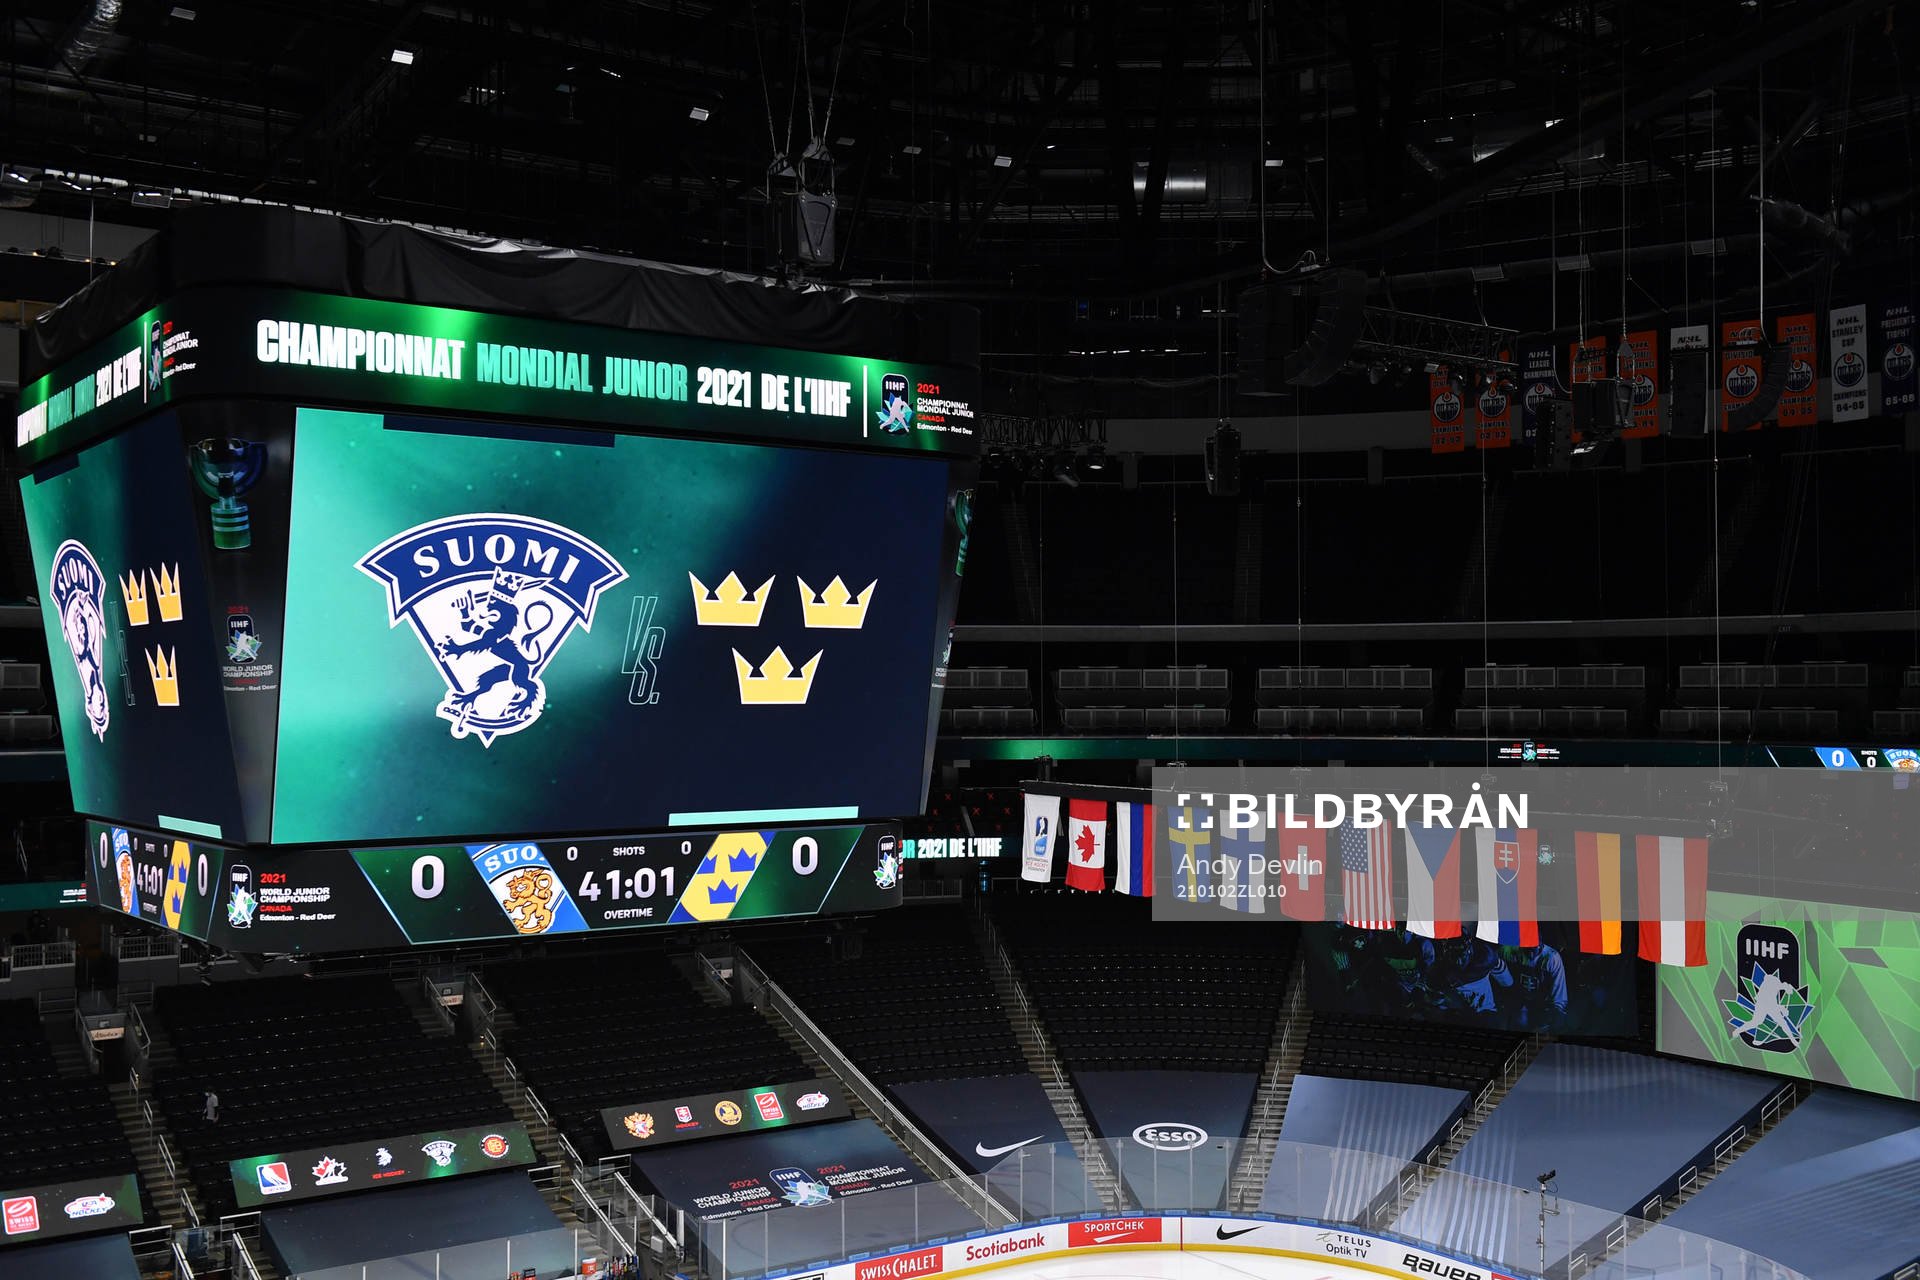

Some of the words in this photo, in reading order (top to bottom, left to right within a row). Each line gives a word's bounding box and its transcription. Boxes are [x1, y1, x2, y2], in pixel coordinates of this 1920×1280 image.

[1837, 316, 1860, 326] NHL
[1832, 325, 1864, 338] STANLEY
[1528, 351, 1551, 359] NHL
[256, 319, 466, 380] CHAMPIONNAT
[477, 343, 593, 393] MONDIAL
[602, 357, 688, 402] JUNIOR
[697, 366, 751, 409] 2021
[761, 373, 789, 412] DE
[795, 377, 851, 418] L'IIHF
[1529, 360, 1551, 369] LEAGUE
[885, 380, 905, 391] IIHF
[917, 383, 940, 395] 2021
[916, 397, 968, 410] CHAMPIONNAT
[916, 405, 951, 416] MONDIAL
[952, 409, 974, 419] JUNIOR
[916, 413, 945, 423] CANADA
[916, 423, 947, 432] Edmonton
[412, 534, 582, 586] SUOMI
[58, 557, 95, 600] SUOMI
[223, 670, 274, 678] CHAMPIONSHIP
[245, 664, 273, 672] JUNIOR
[1831, 750, 1845, 767] 0
[1866, 756, 1877, 768] 0
[115, 832, 130, 853] SUO
[133, 837, 138, 851] 0
[681, 840, 692, 855] 0
[918, 838, 947, 858] 2021
[949, 838, 966, 857] DE
[967, 837, 1002, 857] L'IIHF
[100, 832, 108, 868] 0
[163, 844, 168, 858] 0
[566, 846, 578, 862] 0
[613, 846, 646, 857] SHOTS
[792, 836, 818, 876] 0
[484, 844, 543, 873] SUO
[137, 862, 163, 897] 41:01
[197, 853, 208, 896] 0
[260, 873, 287, 884] 2021
[411, 855, 445, 899] 0
[579, 866, 676, 902] 41:01
[260, 888, 292, 896] WORLD
[293, 887, 330, 896] JUNIOR
[260, 894, 331, 904] CHAMPIONSHIP
[260, 905, 293, 913] CANADA
[603, 907, 653, 920] OVERTIME
[260, 913, 295, 921] Edmonton
[1745, 938, 1790, 960] IIHF
[776, 1171, 803, 1181] IIHF
[817, 1164, 847, 1175] 2021
[825, 1165, 890, 1182] CHAMPIONNAT
[829, 1174, 871, 1187] MONDIAL
[871, 1166, 907, 1179] JUNIOR
[728, 1178, 760, 1190] 2021
[835, 1181, 871, 1192] CANADA
[840, 1186, 878, 1197] Edmonton
[881, 1182, 897, 1190] Red
[898, 1178, 914, 1187] Deer
[693, 1193, 731, 1204] WORLD
[732, 1186, 768, 1199] JUNIOR
[697, 1190, 772, 1209] CHAMPIONSHIP
[740, 1196, 779, 1208] CANADA
[71, 1207, 107, 1217] HOCKEY
[701, 1209, 742, 1221] Edmonton
[747, 1205, 763, 1214] Red
[764, 1202, 782, 1211] Deer
[8, 1215, 35, 1226] SWISS
[966, 1232, 1046, 1261] Scotiabank
[1337, 1234, 1372, 1248] TELUS
[1325, 1243, 1352, 1257] Optik
[1354, 1248, 1367, 1259] TV
[861, 1263, 891, 1280] SWISS
[892, 1254, 937, 1278] CHALET
